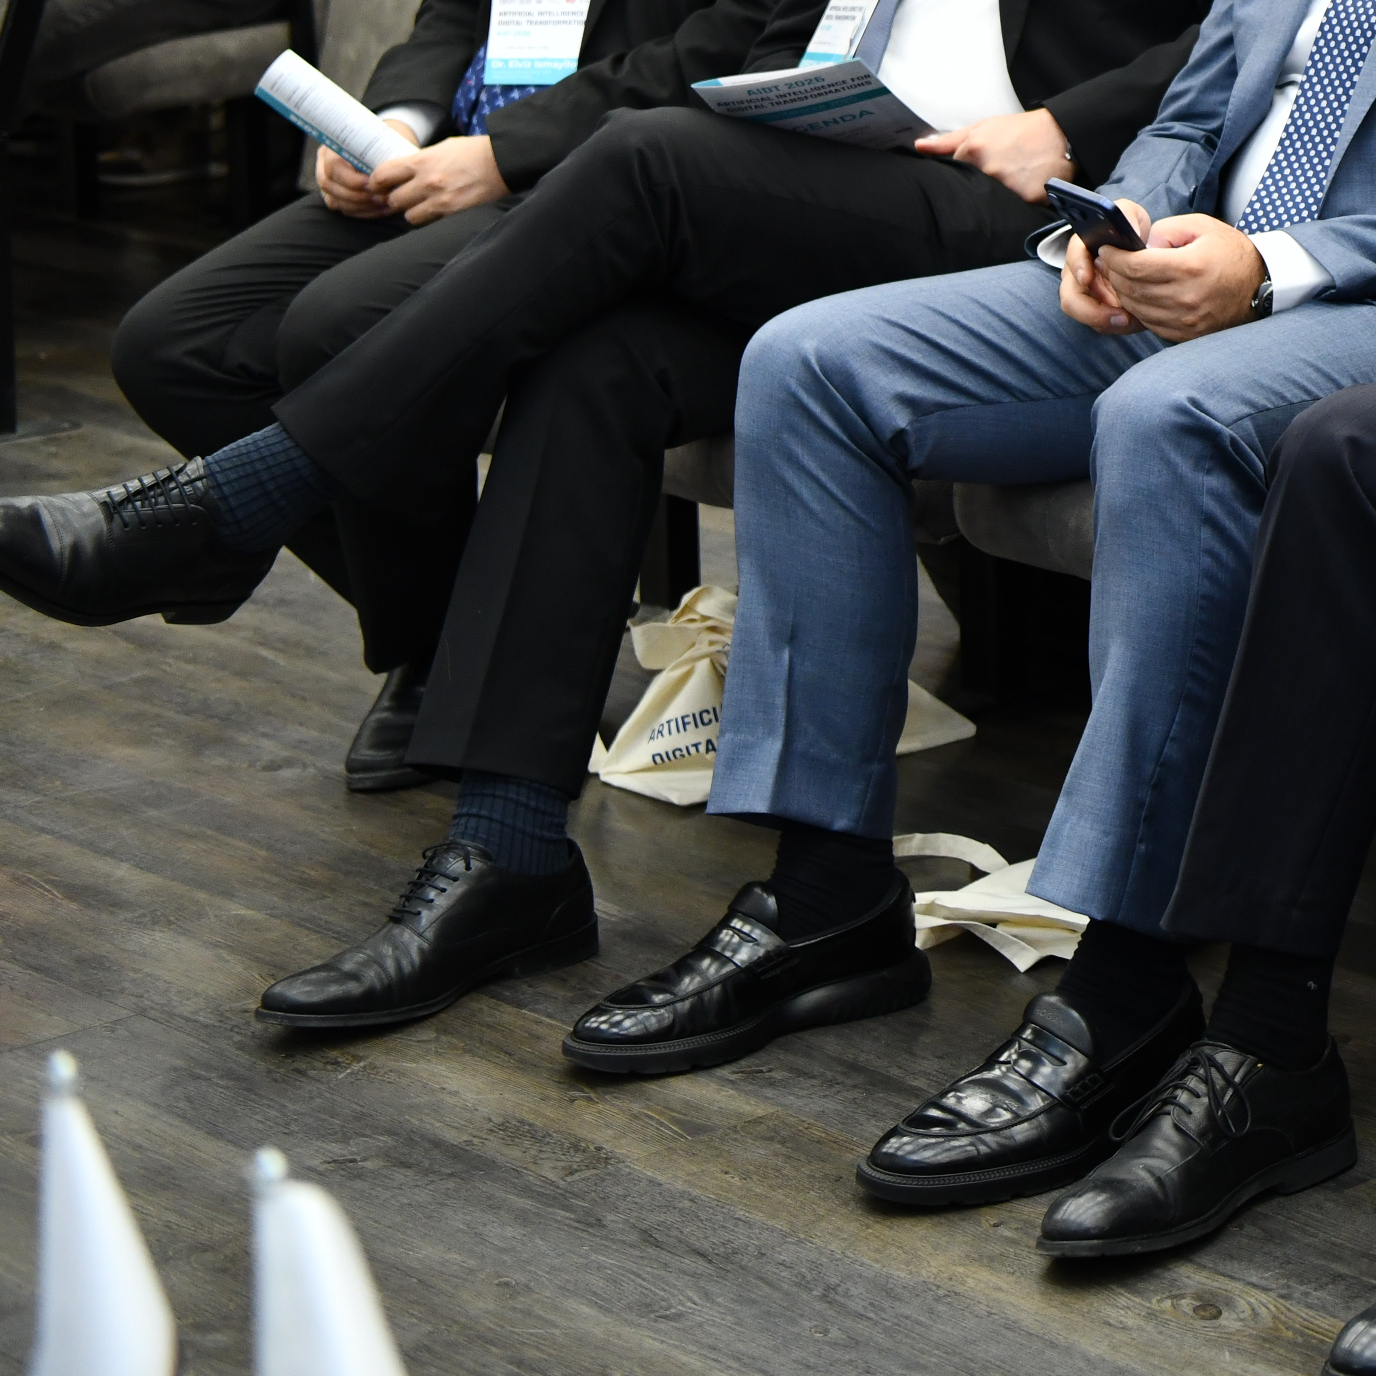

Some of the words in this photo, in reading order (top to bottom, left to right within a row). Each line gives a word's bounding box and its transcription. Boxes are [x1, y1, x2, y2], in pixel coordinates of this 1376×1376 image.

[492, 60, 506, 68] Dr.
[716, 94, 772, 107] ARTIFICIAL
[775, 80, 849, 99] INTELLIGENCE
[851, 74, 872, 84] FOR
[746, 84, 781, 96] AIDT
[784, 76, 826, 90] 2026
[769, 80, 873, 106] TRANSFORMATIONS
[648, 704, 722, 744] ARTIFICI
